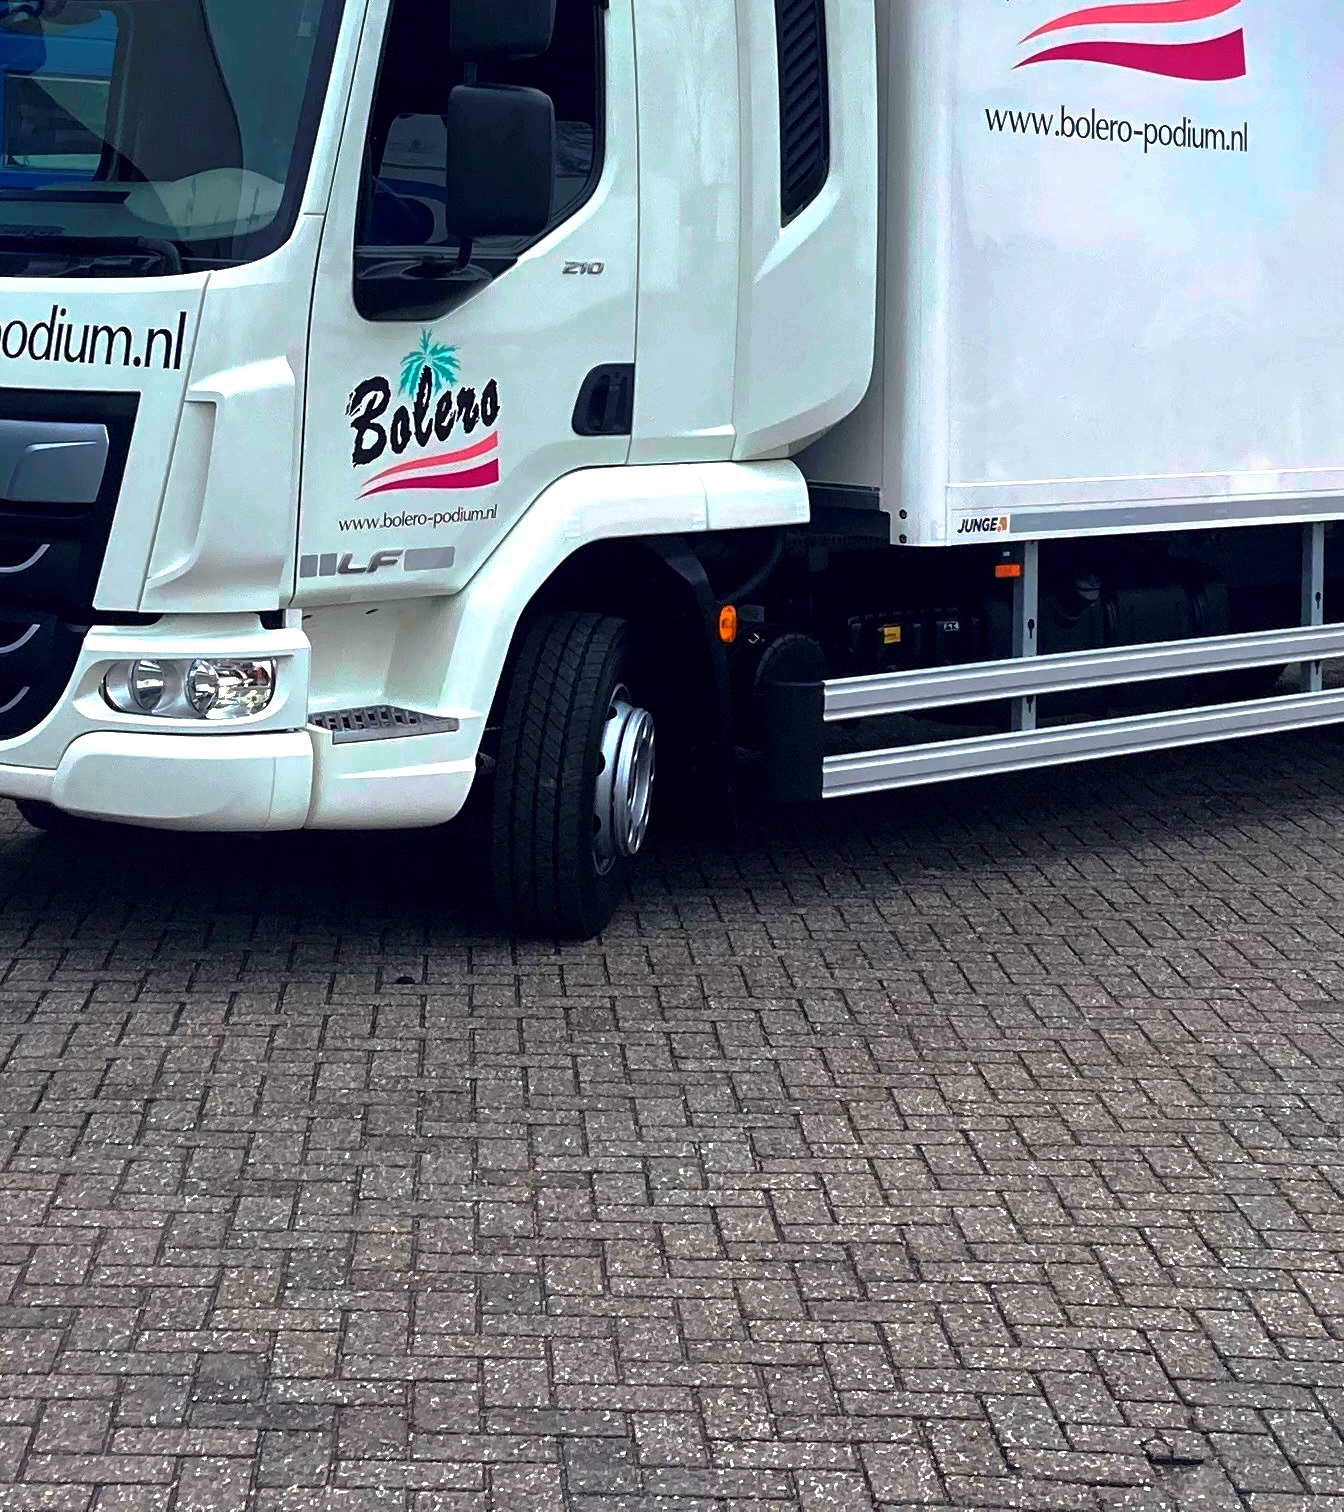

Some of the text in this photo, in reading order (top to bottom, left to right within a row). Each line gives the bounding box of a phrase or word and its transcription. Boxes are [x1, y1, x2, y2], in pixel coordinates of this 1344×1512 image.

[984, 104, 1249, 154] www.bolero-podium.nl
[562, 260, 605, 275] 210
[346, 365, 500, 468] Bolero
[338, 504, 498, 532] www.bolero-podium.nl
[957, 516, 999, 534] JUNGE
[336, 549, 404, 575] LF
